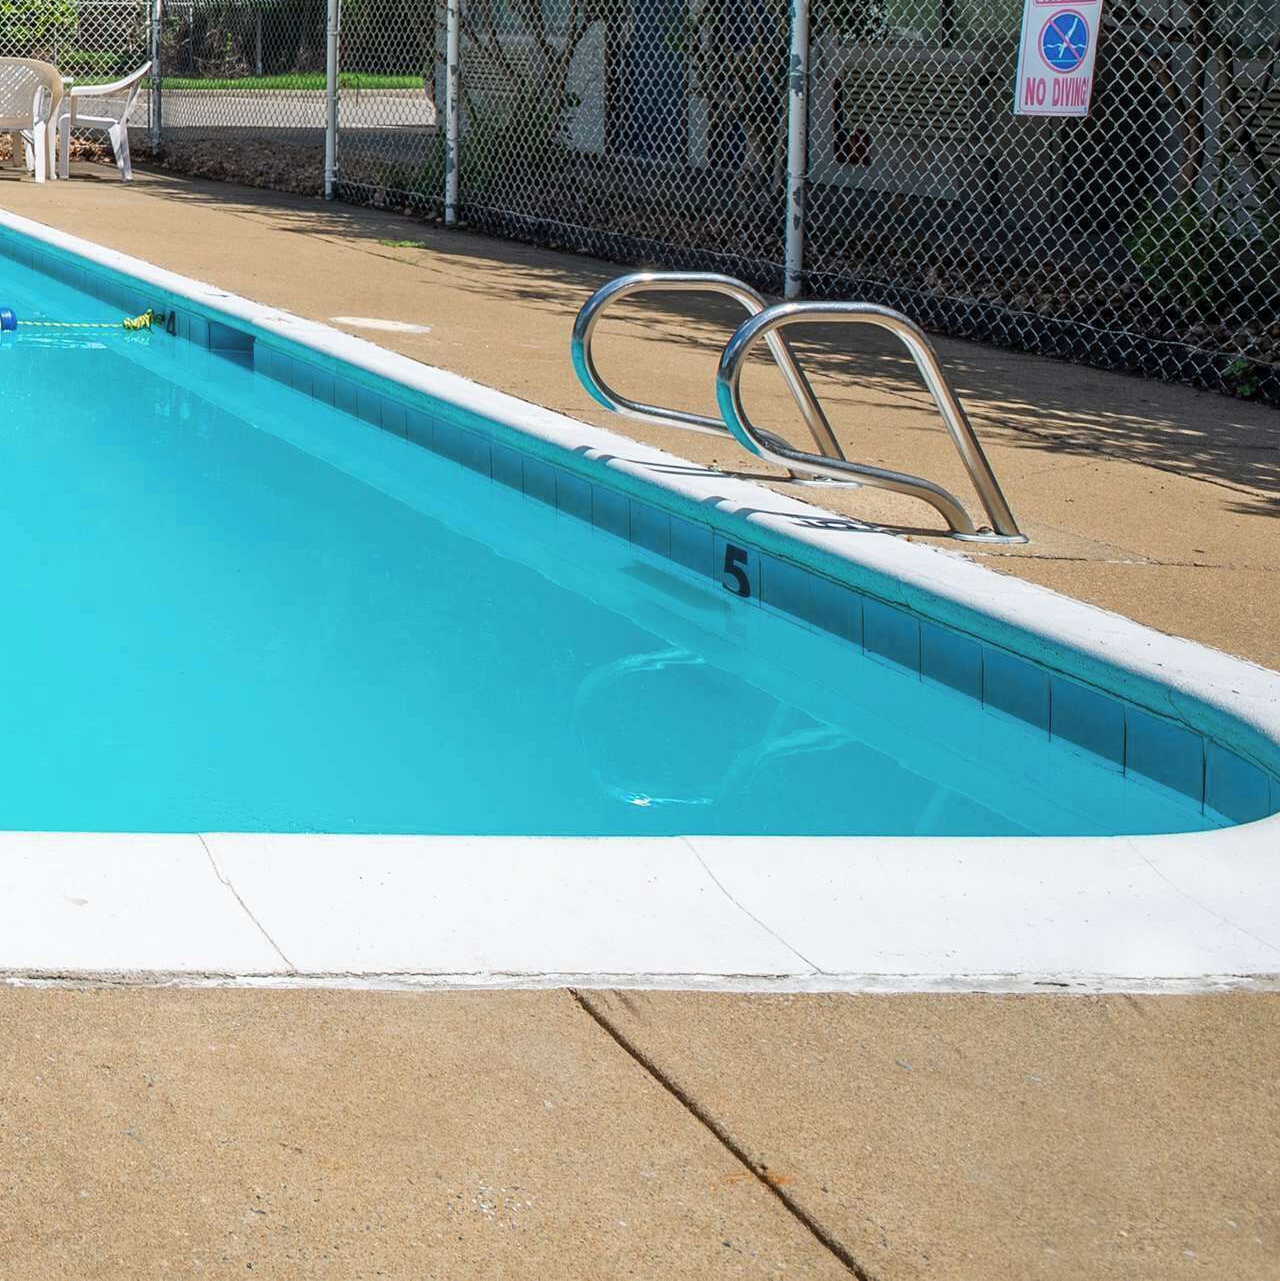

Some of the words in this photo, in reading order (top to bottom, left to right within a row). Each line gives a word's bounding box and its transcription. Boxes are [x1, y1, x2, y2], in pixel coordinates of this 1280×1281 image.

[1024, 77, 1047, 106] NO
[1052, 77, 1090, 107] DIVING!
[721, 543, 752, 599] 5
